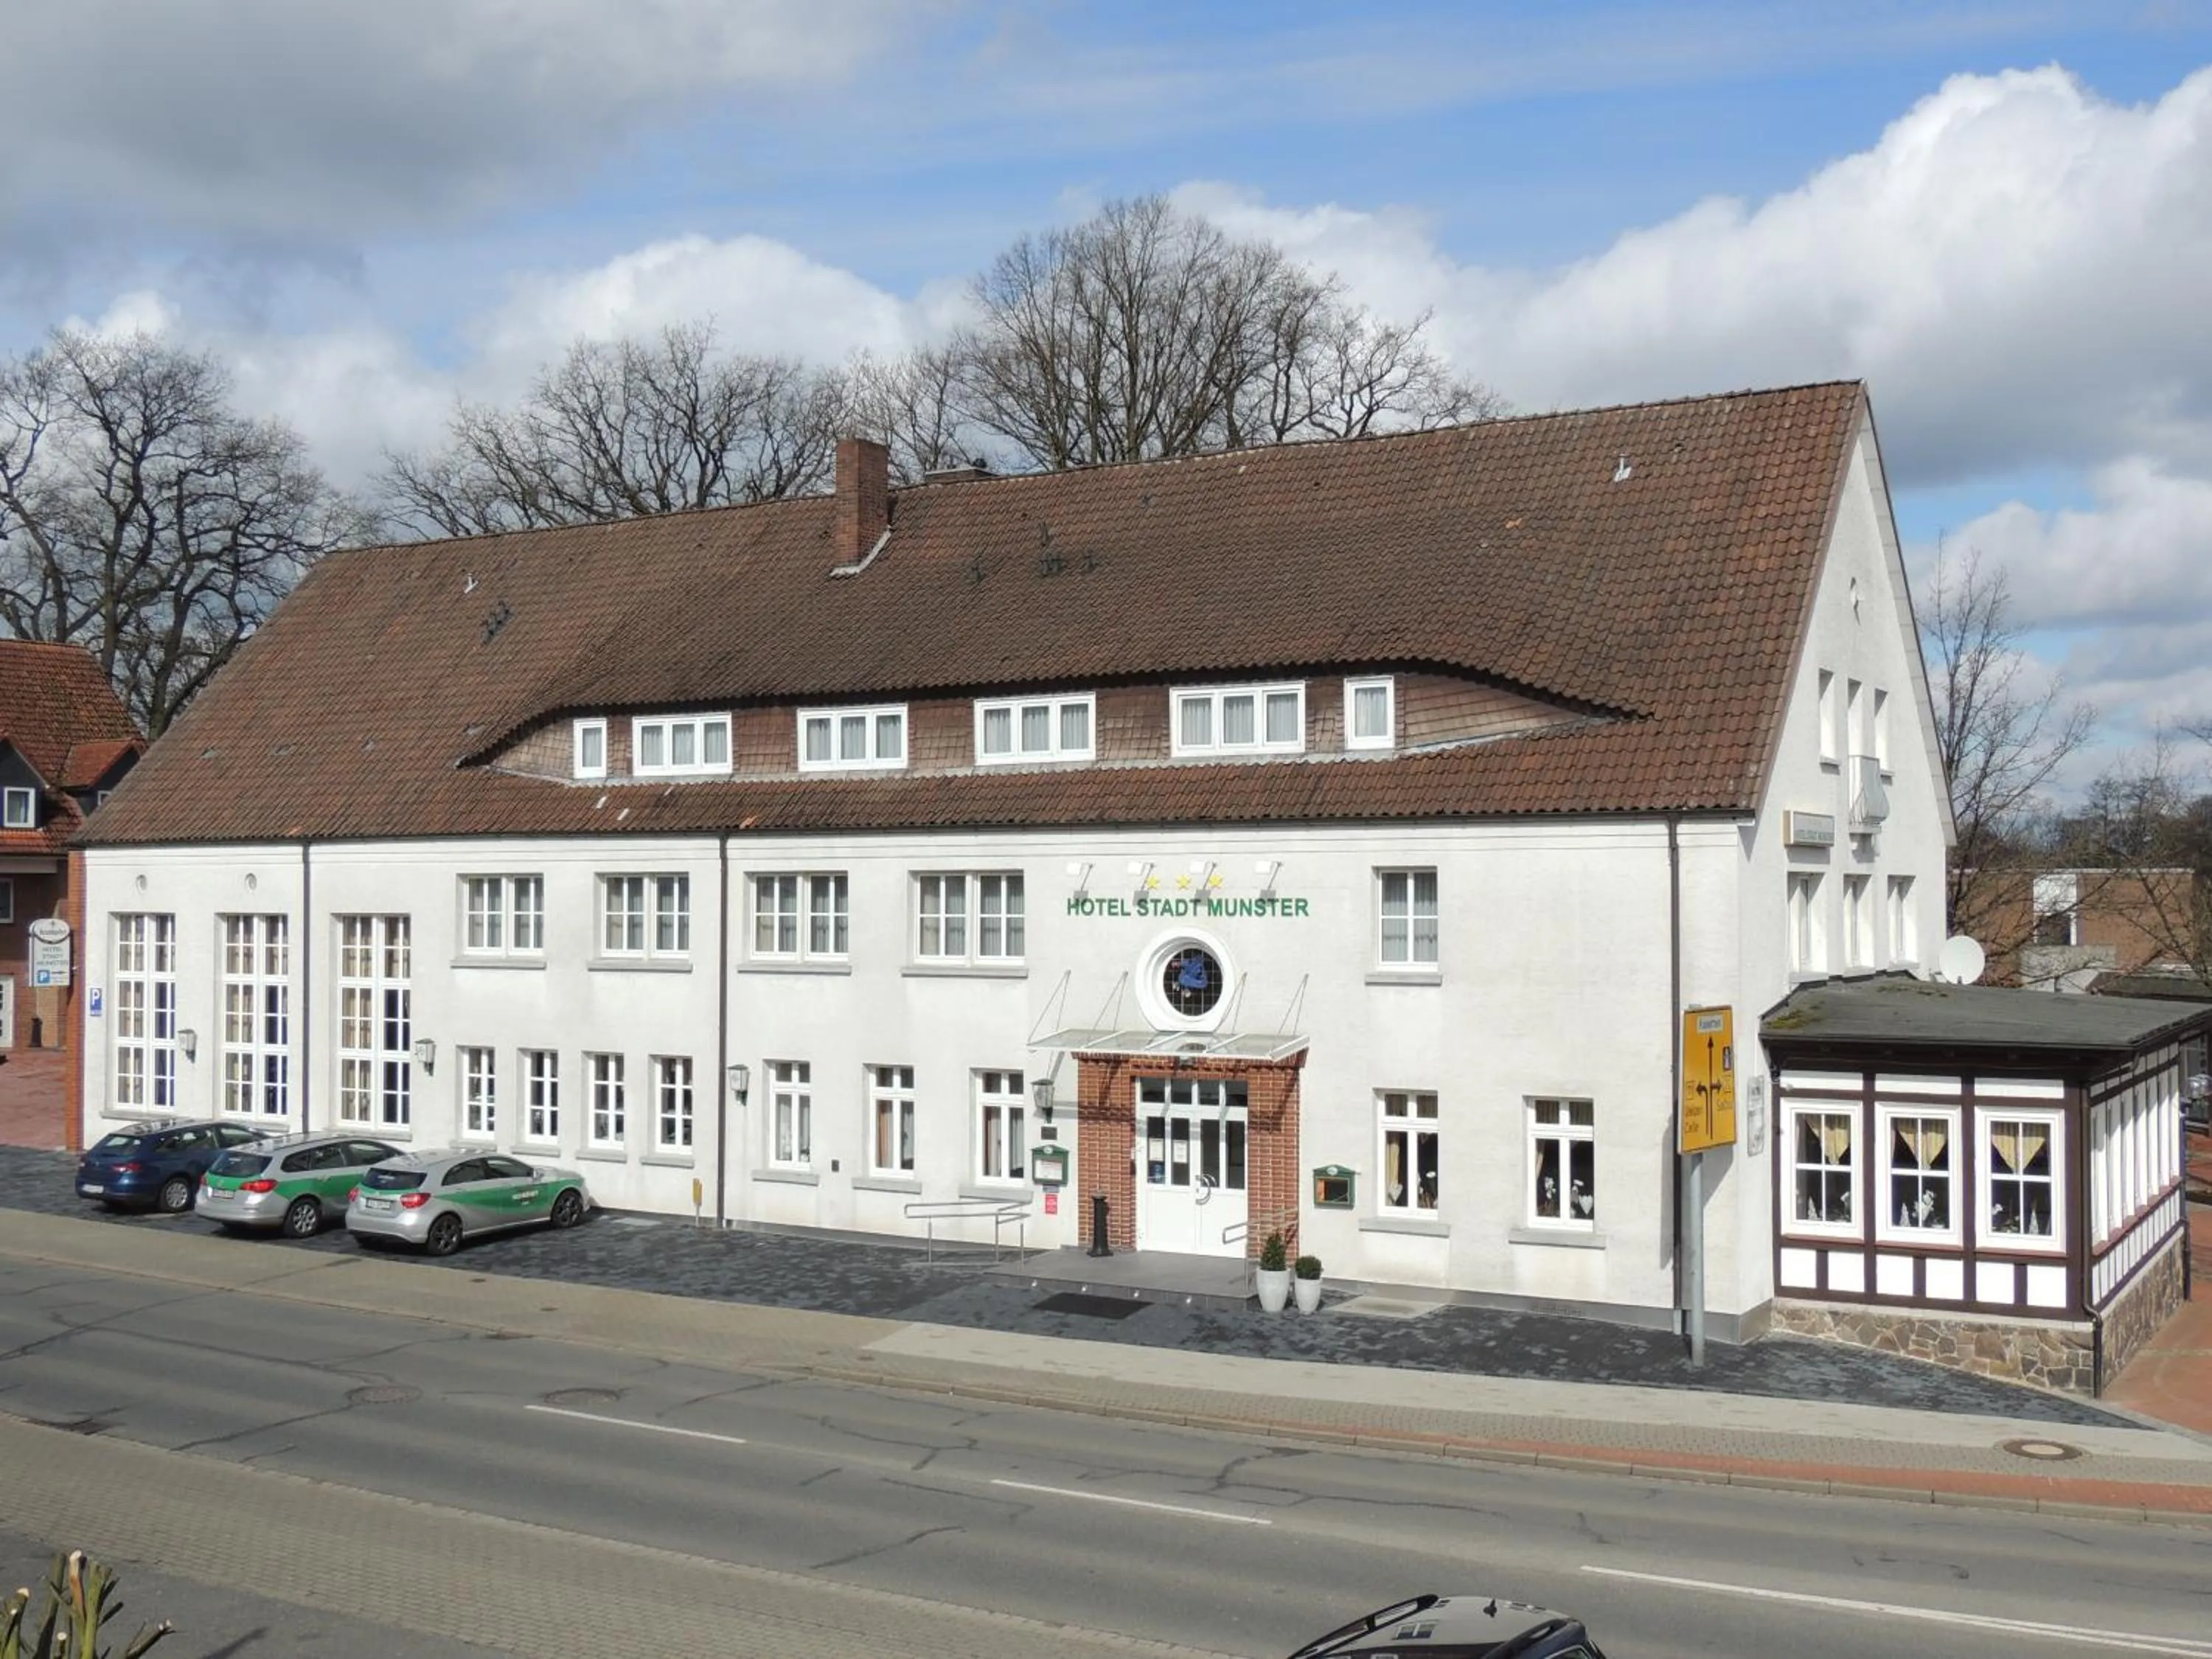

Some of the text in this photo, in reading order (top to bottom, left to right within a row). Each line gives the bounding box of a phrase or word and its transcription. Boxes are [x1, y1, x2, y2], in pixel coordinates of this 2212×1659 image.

[1067, 898, 1310, 917] HOTEL STADT MUNSTER
[92, 989, 100, 1006] P
